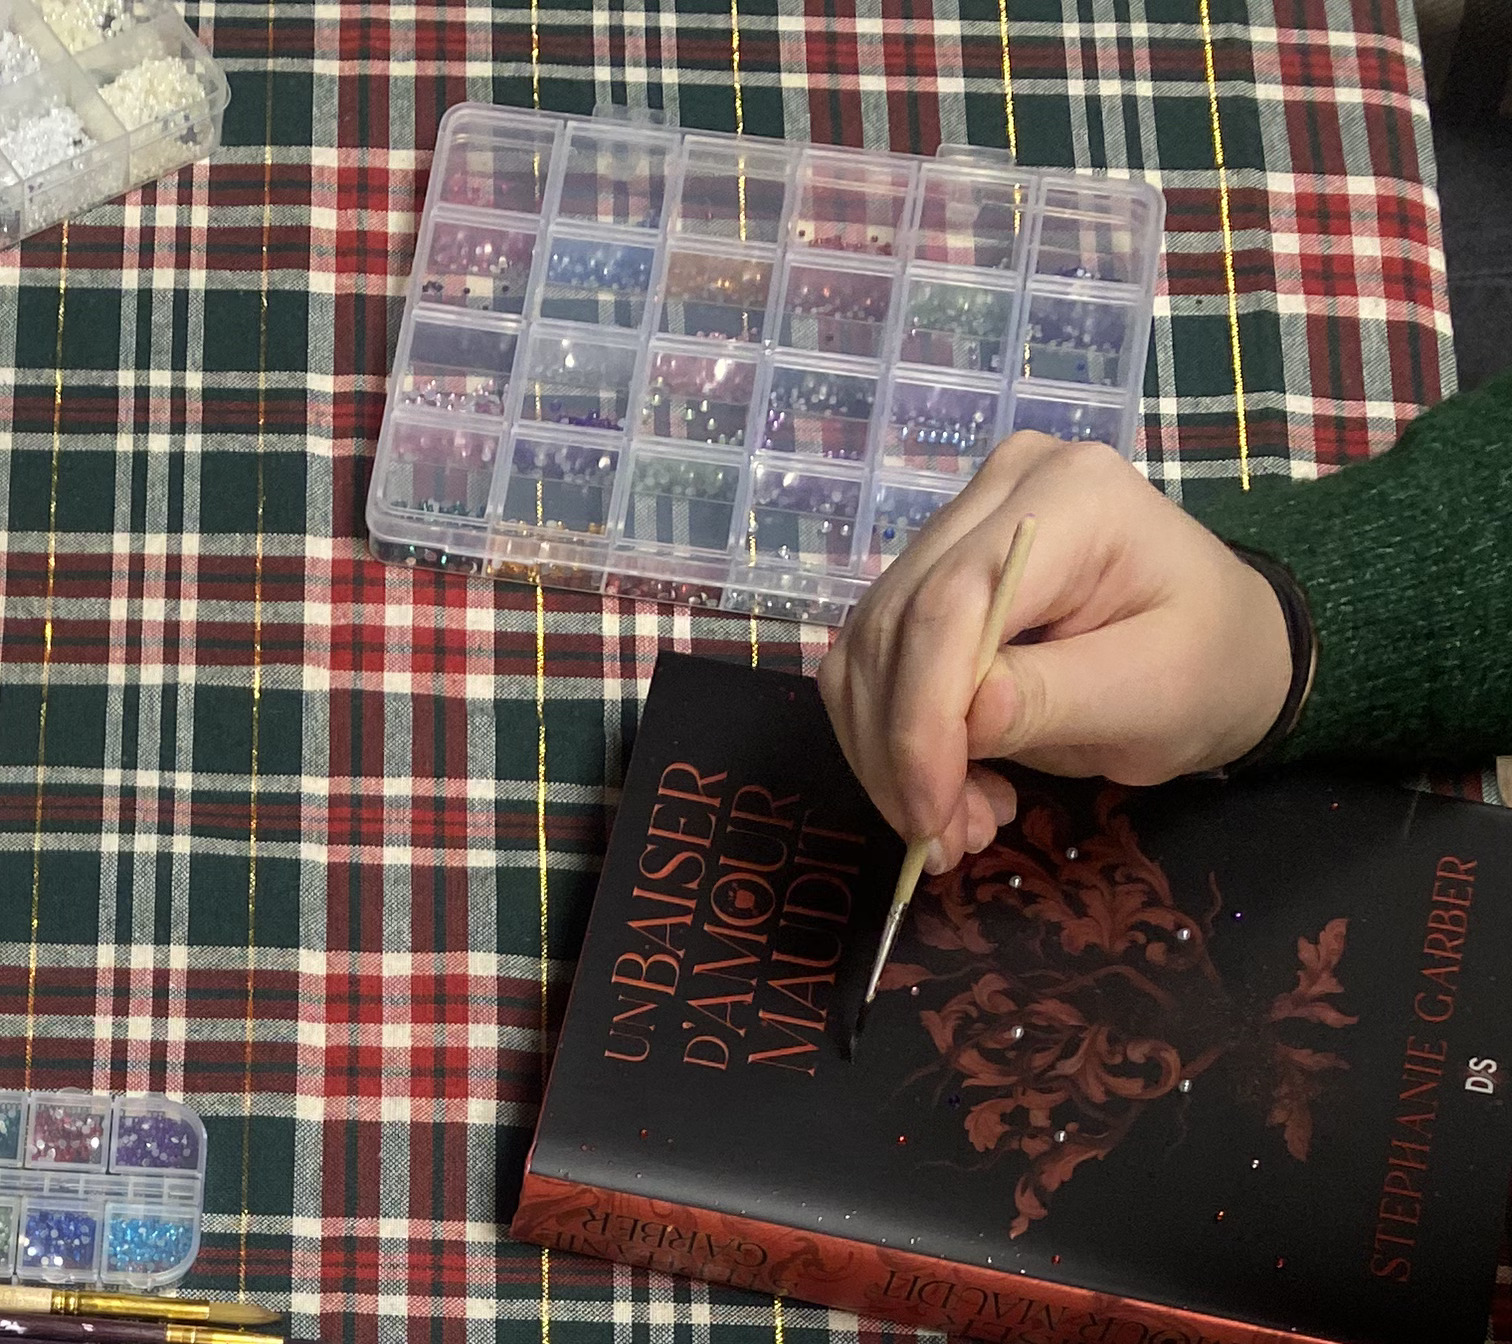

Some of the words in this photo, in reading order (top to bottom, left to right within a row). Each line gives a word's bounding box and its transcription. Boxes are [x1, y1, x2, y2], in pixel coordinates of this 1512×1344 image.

[611, 761, 728, 997] BAISER
[682, 784, 800, 1071] D'AMOUR
[748, 808, 866, 1077] MAUDIT
[604, 993, 658, 1062] UN
[1370, 1035, 1448, 1284] STEPHANIE
[1414, 854, 1478, 1024] GARBER
[581, 1207, 768, 1269] GARBER
[881, 1270, 1068, 1332] MAUDIT
